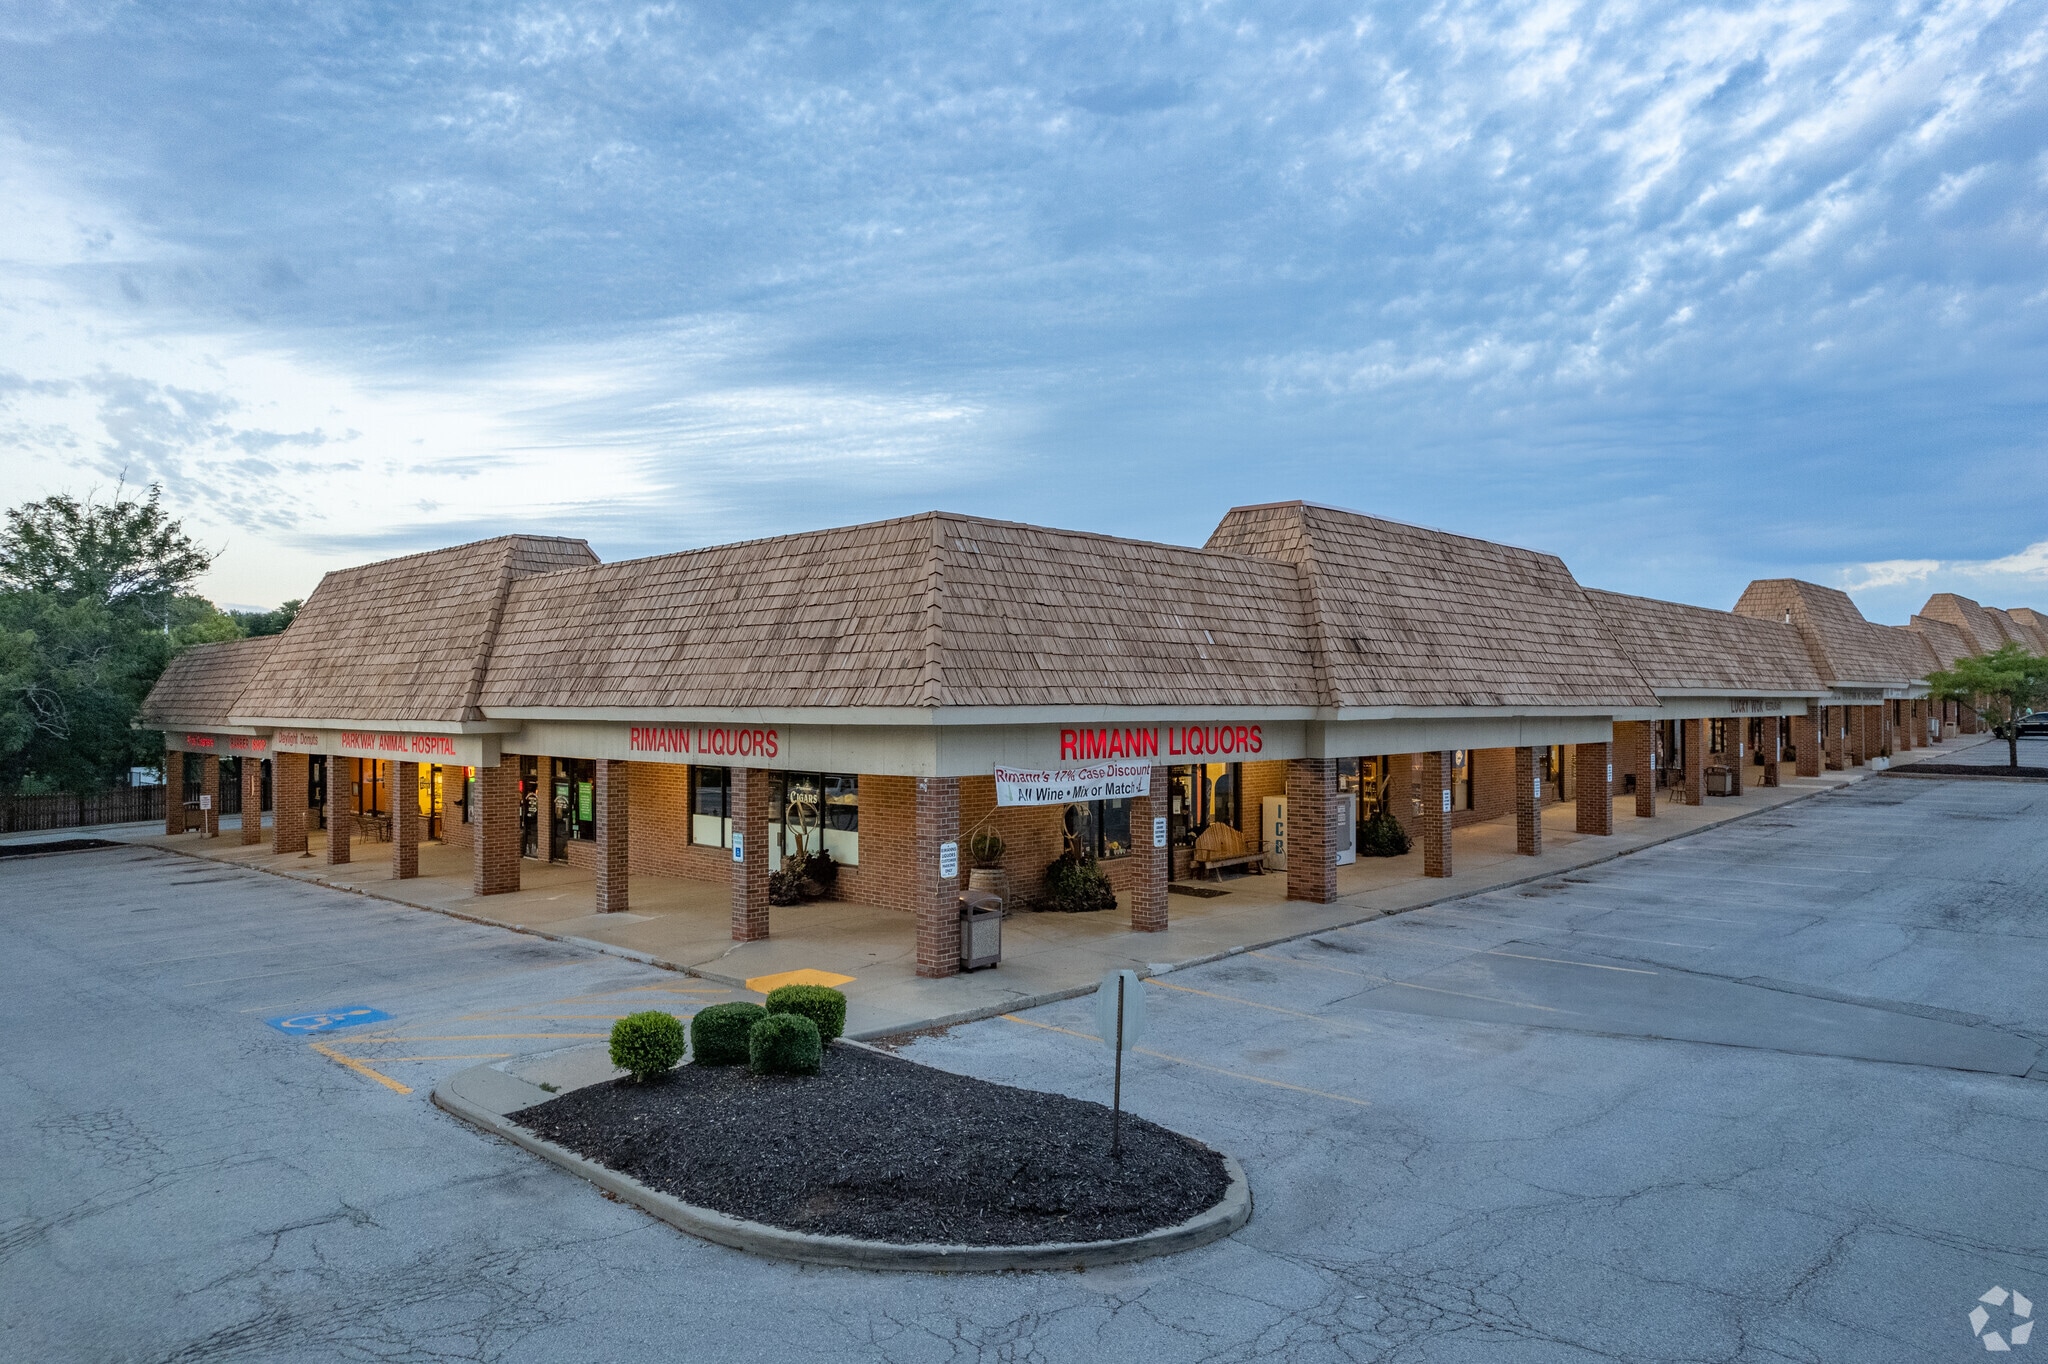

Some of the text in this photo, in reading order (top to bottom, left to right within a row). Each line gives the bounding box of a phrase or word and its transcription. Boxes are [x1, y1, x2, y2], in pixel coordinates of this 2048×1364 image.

[278, 732, 319, 746] Daylight Donuts
[341, 732, 456, 755] PARKWAY ANIMAL HOSPITAL
[630, 727, 778, 758] RIMANN LIQUORS
[1060, 725, 1263, 760] RIMANN LIQUORS
[995, 763, 1151, 783] Rimann's 17% Case Discount
[790, 790, 818, 804] CIGARS
[1018, 788, 1033, 801] All
[1036, 788, 1064, 801] Wine
[1072, 785, 1088, 799] Mix
[1091, 786, 1103, 796] or
